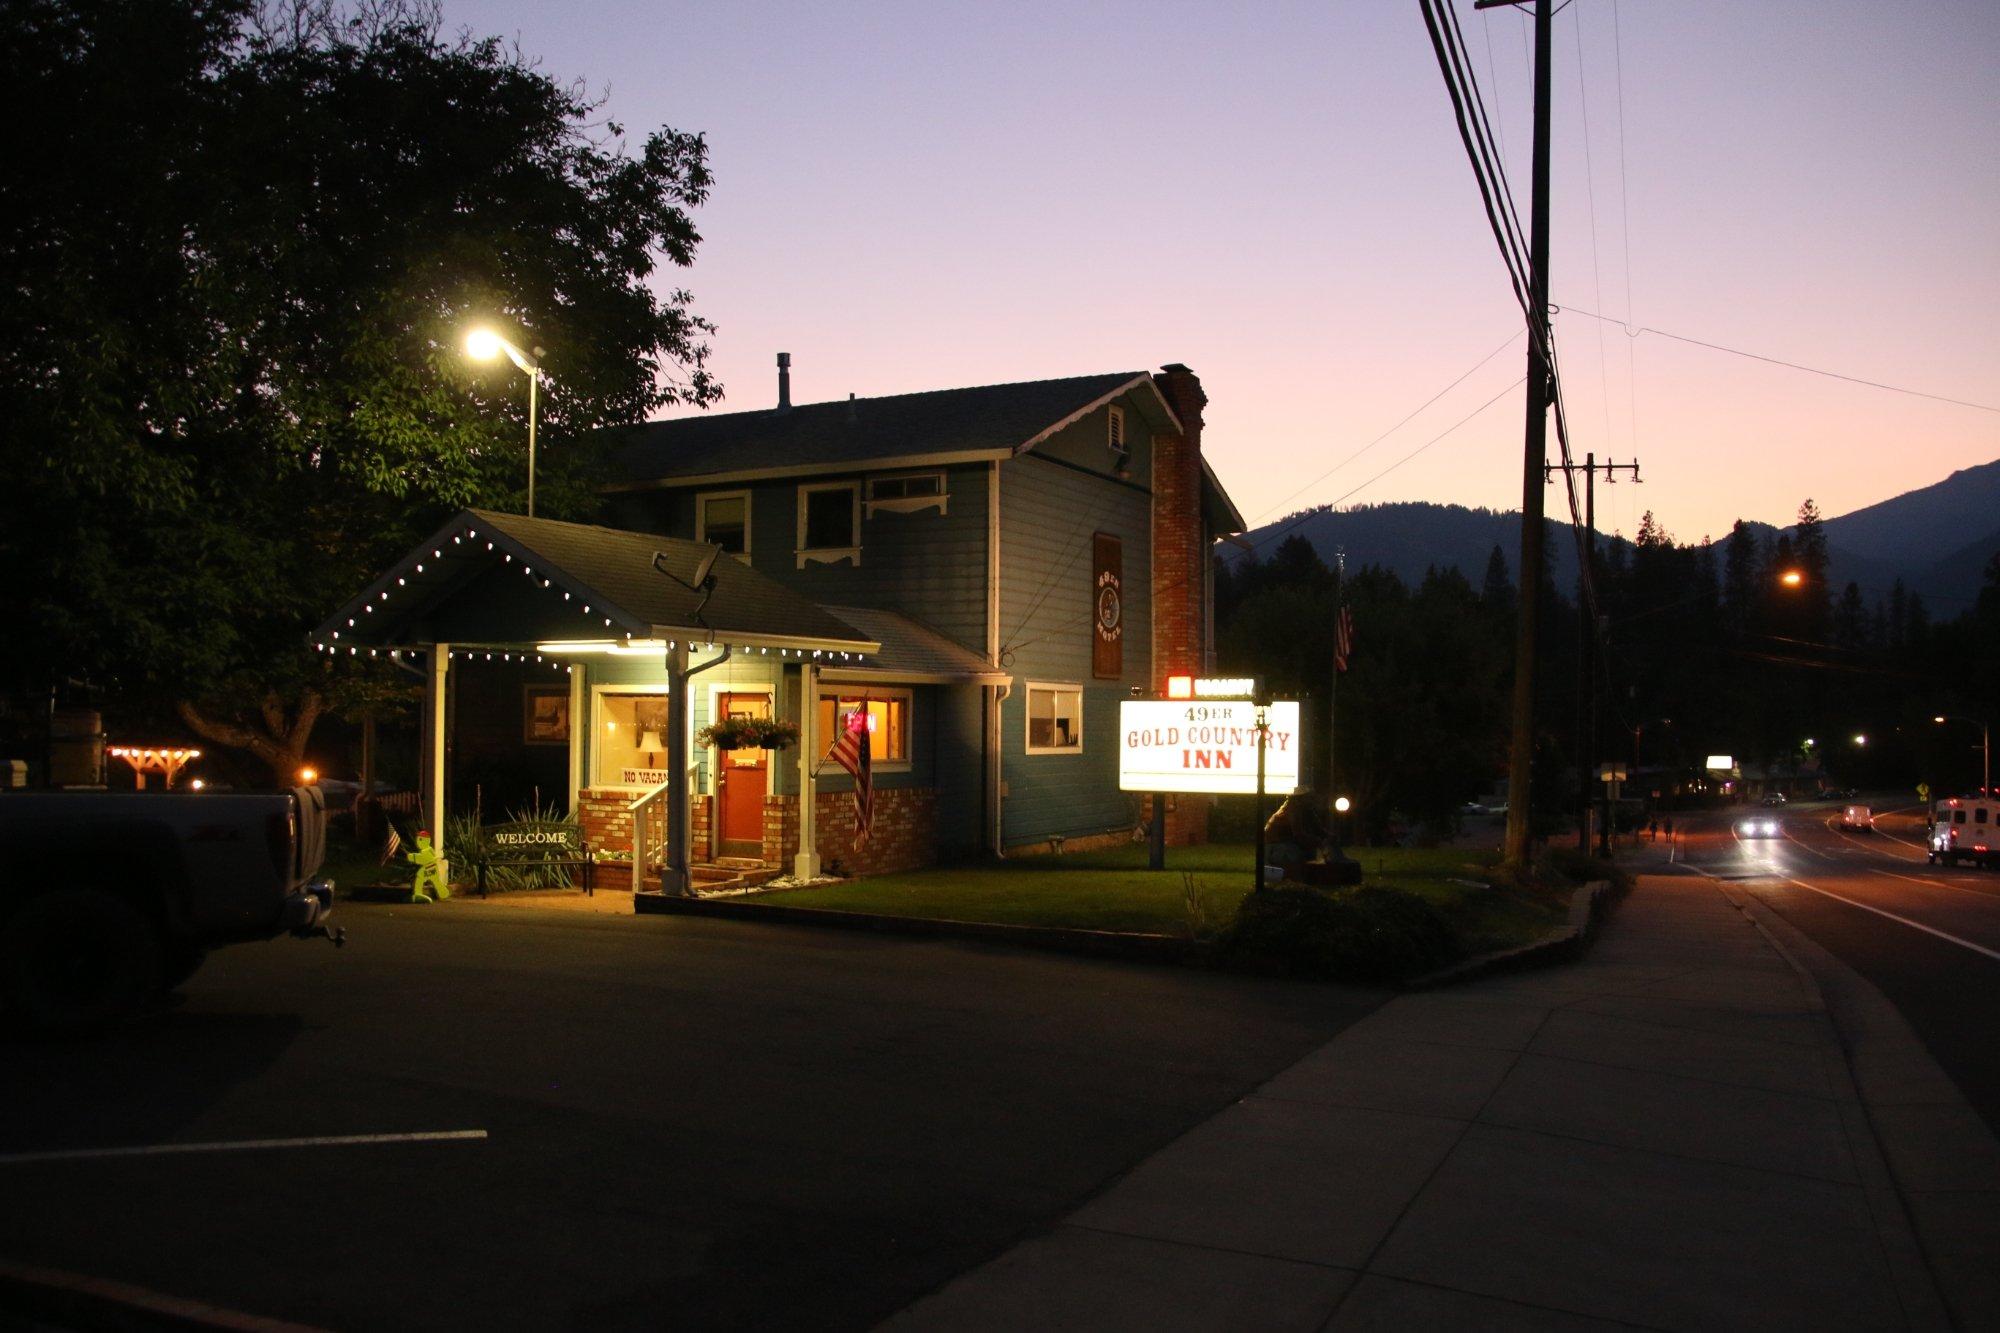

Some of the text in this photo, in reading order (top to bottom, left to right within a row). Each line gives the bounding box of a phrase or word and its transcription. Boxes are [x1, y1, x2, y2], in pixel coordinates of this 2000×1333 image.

[1184, 707, 1232, 721] 49ER
[1128, 726, 1290, 750] GOLD COUNTRY
[1183, 750, 1232, 768] INN
[624, 771, 636, 783] NO
[496, 832, 567, 844] WELCOME
